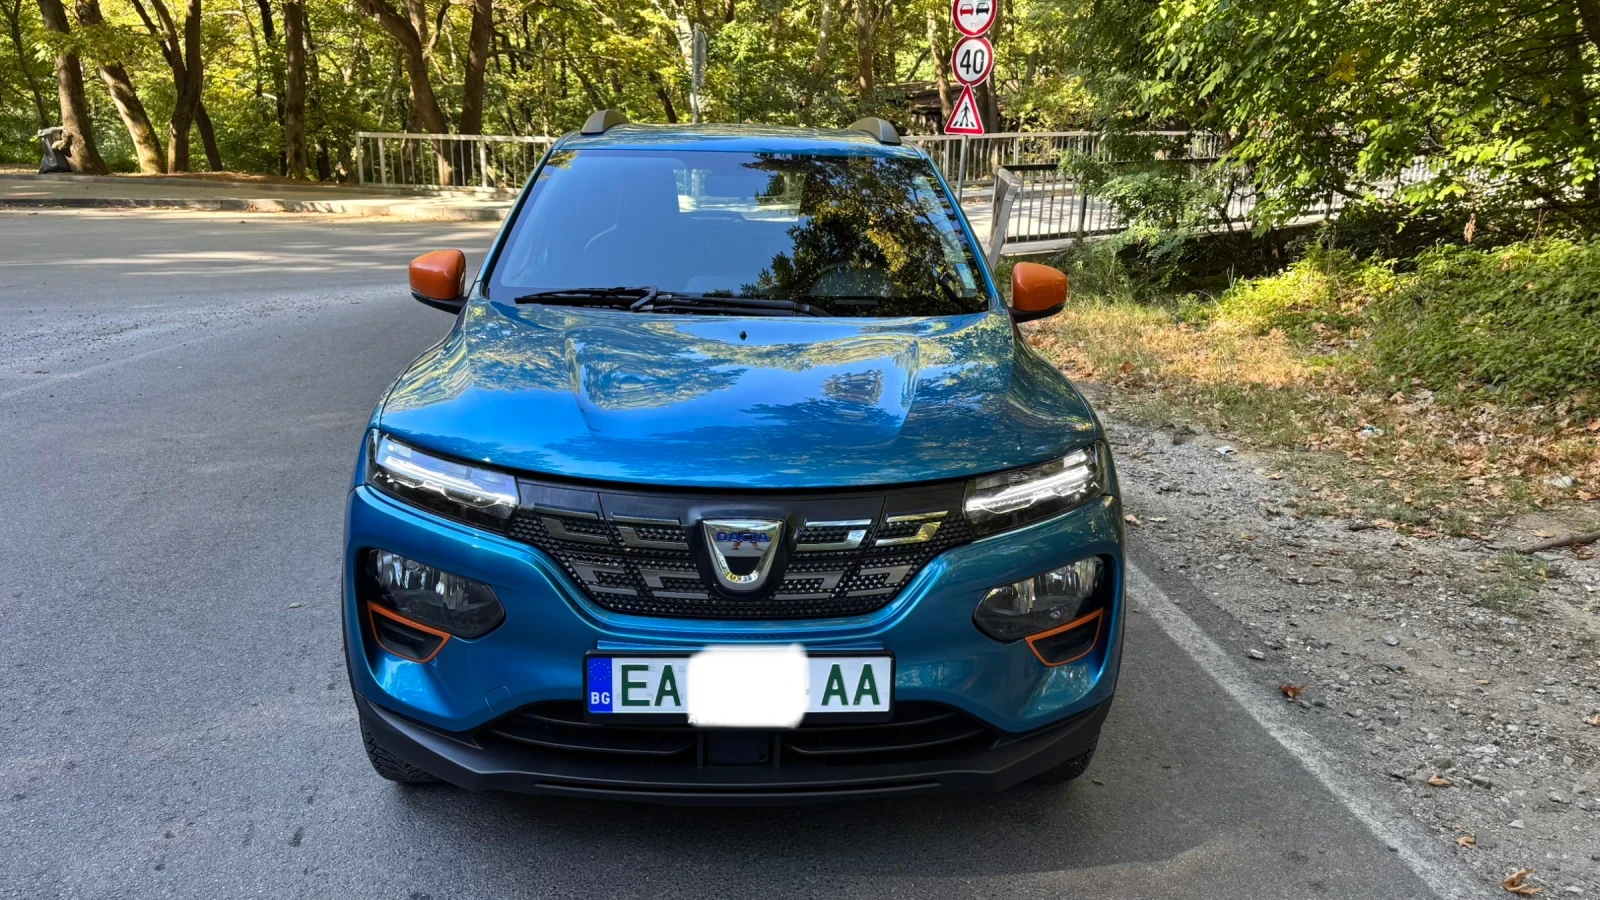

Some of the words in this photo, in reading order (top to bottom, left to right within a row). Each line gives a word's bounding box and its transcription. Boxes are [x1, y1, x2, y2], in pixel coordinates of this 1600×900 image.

[960, 49, 985, 75] 40
[716, 531, 769, 542] DACIA
[621, 664, 681, 706] EA
[821, 663, 880, 706] AA
[590, 691, 611, 705] BG
